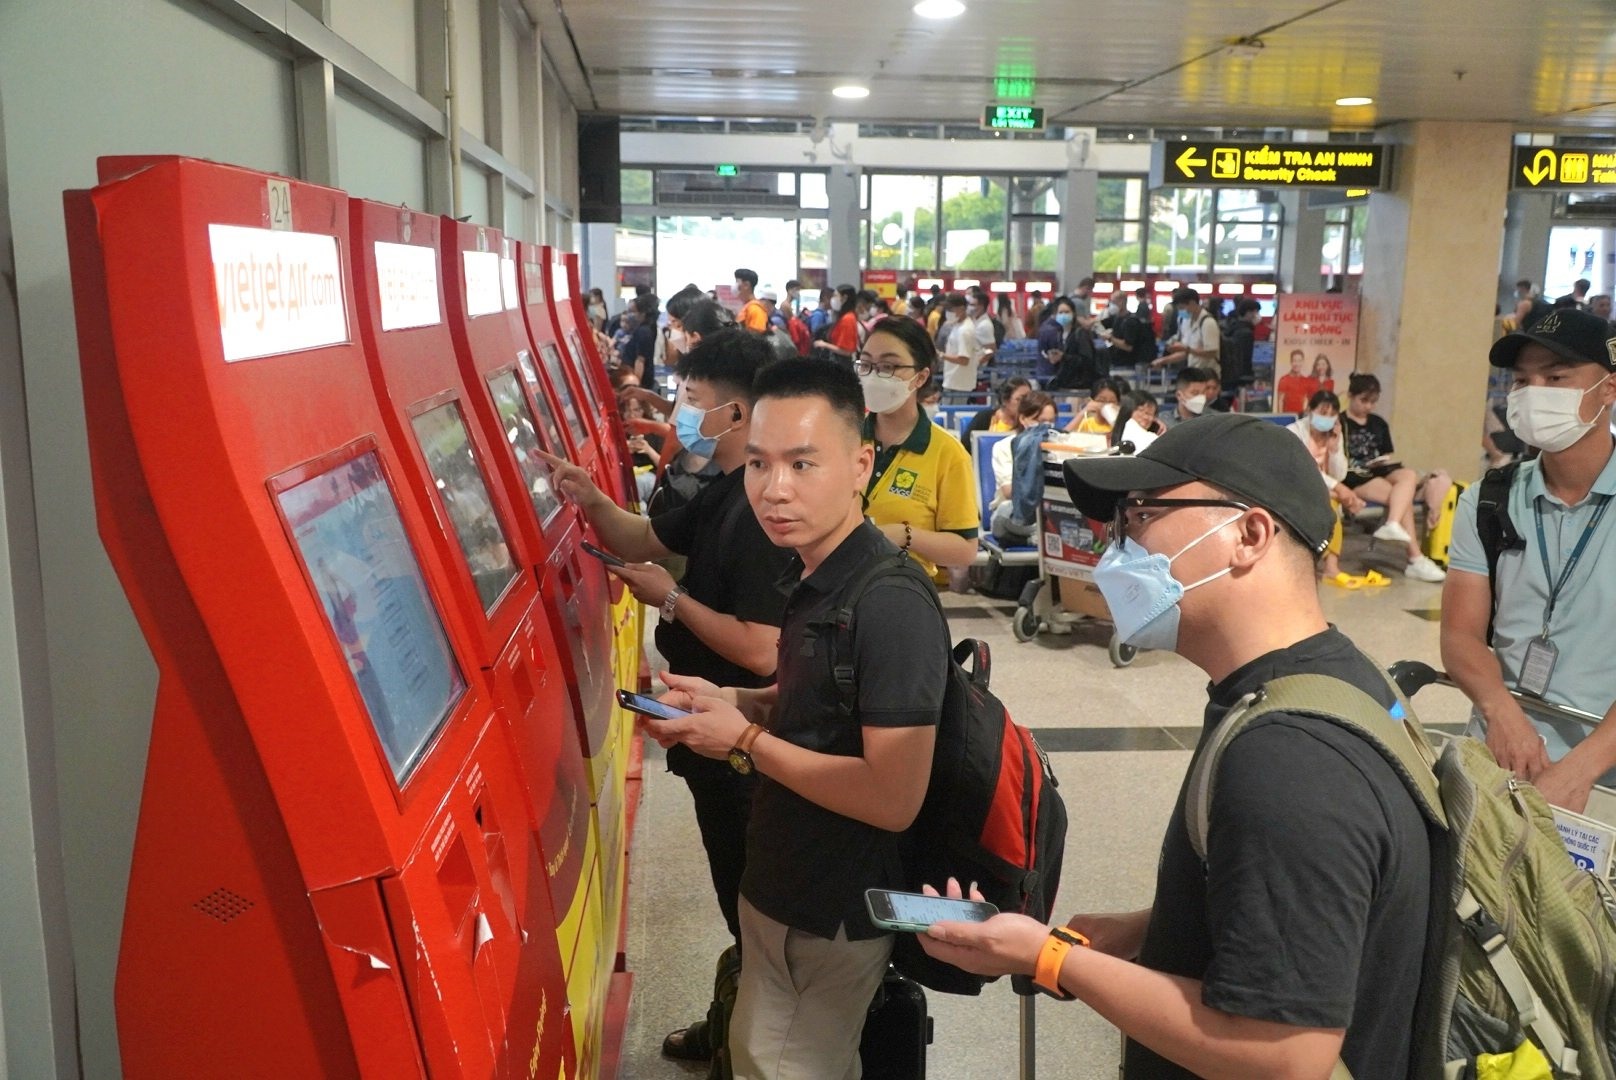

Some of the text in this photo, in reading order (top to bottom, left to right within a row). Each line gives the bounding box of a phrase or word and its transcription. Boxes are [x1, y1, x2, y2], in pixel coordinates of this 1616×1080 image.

[996, 106, 1032, 119] EXIT
[1244, 145, 1373, 166] KIỂM TRA AN NINH
[1244, 167, 1337, 183] Security Check
[271, 186, 290, 223] 24
[890, 486, 911, 498] SAGS
